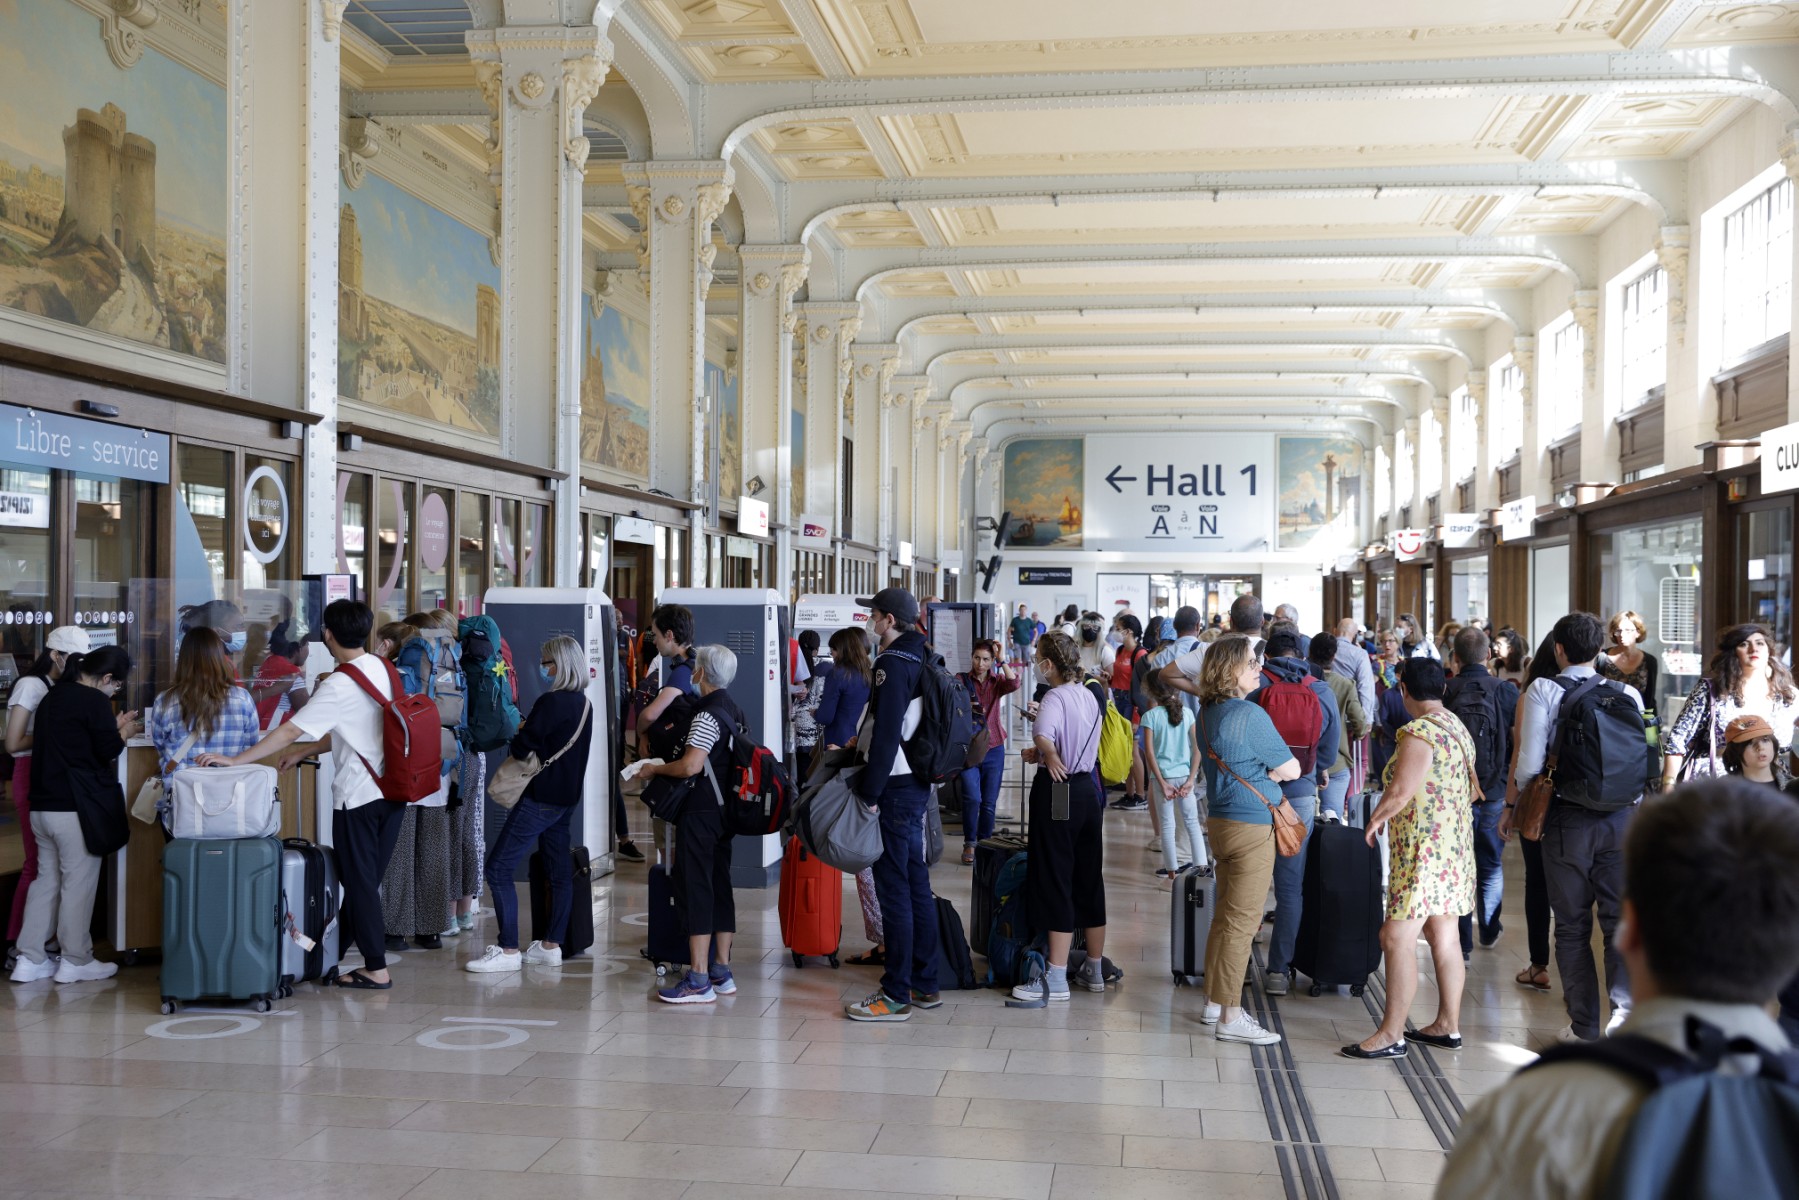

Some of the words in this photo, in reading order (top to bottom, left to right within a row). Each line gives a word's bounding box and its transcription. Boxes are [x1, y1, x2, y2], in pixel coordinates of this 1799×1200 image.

[422, 150, 448, 171] MONTPELLIER
[15, 417, 71, 457] Libre
[92, 439, 159, 471] service
[1147, 464, 1226, 496] Hall
[1240, 464, 1256, 496] 1
[261, 499, 280, 510] voyage
[804, 528, 826, 537] SNCF
[1151, 515, 1170, 535] A
[1180, 510, 1189, 523] à
[1200, 515, 1217, 535] N
[261, 529, 270, 538] ici
